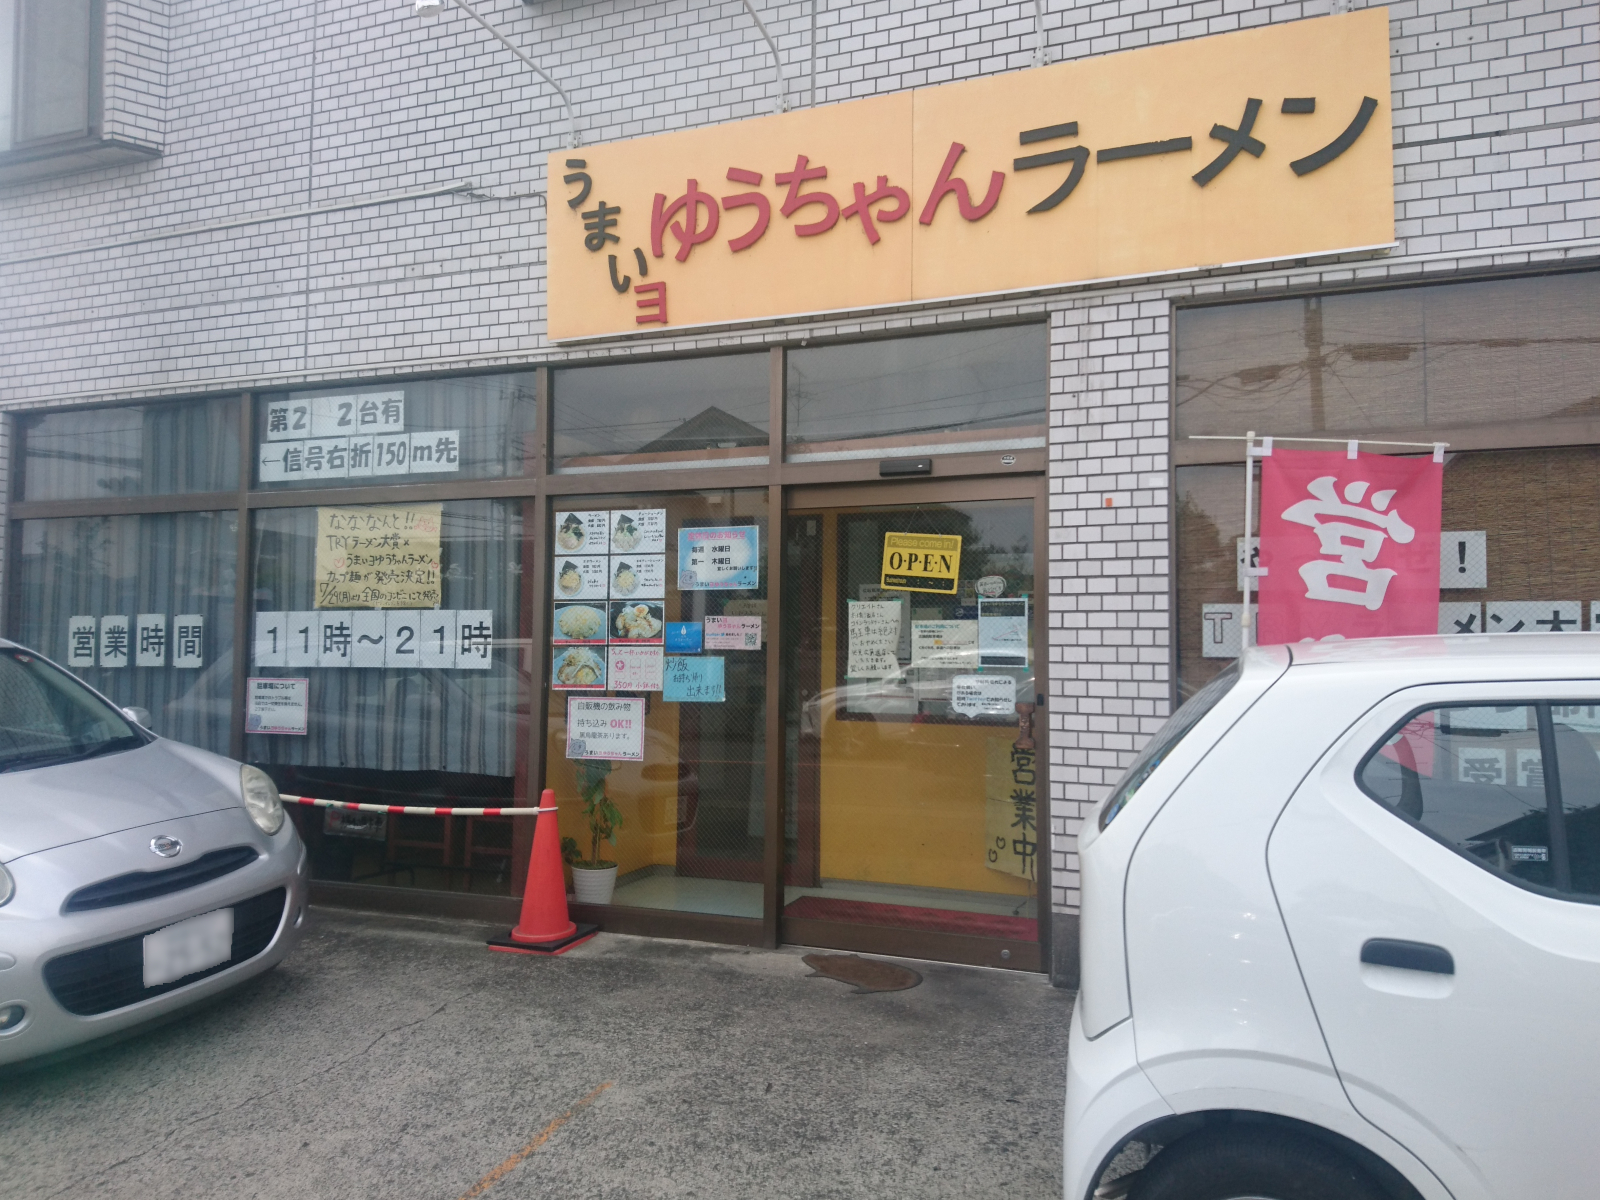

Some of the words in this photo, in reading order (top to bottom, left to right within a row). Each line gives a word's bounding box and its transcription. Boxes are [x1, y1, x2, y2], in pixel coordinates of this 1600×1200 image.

[269, 405, 307, 433] 第2
[337, 397, 403, 428] 2台有
[282, 436, 458, 474] 信号右折150m先
[711, 545, 731, 553] 水曜日
[890, 537, 918, 547] Please
[919, 539, 942, 548] come
[943, 540, 955, 549] in!
[1281, 475, 1416, 642] 営
[72, 625, 203, 659] 営業時間
[665, 657, 690, 672] 炒飯
[577, 701, 632, 712] 自販機の飲み物
[577, 718, 608, 728] 持ち込み
[1010, 742, 1038, 875] 営業中
